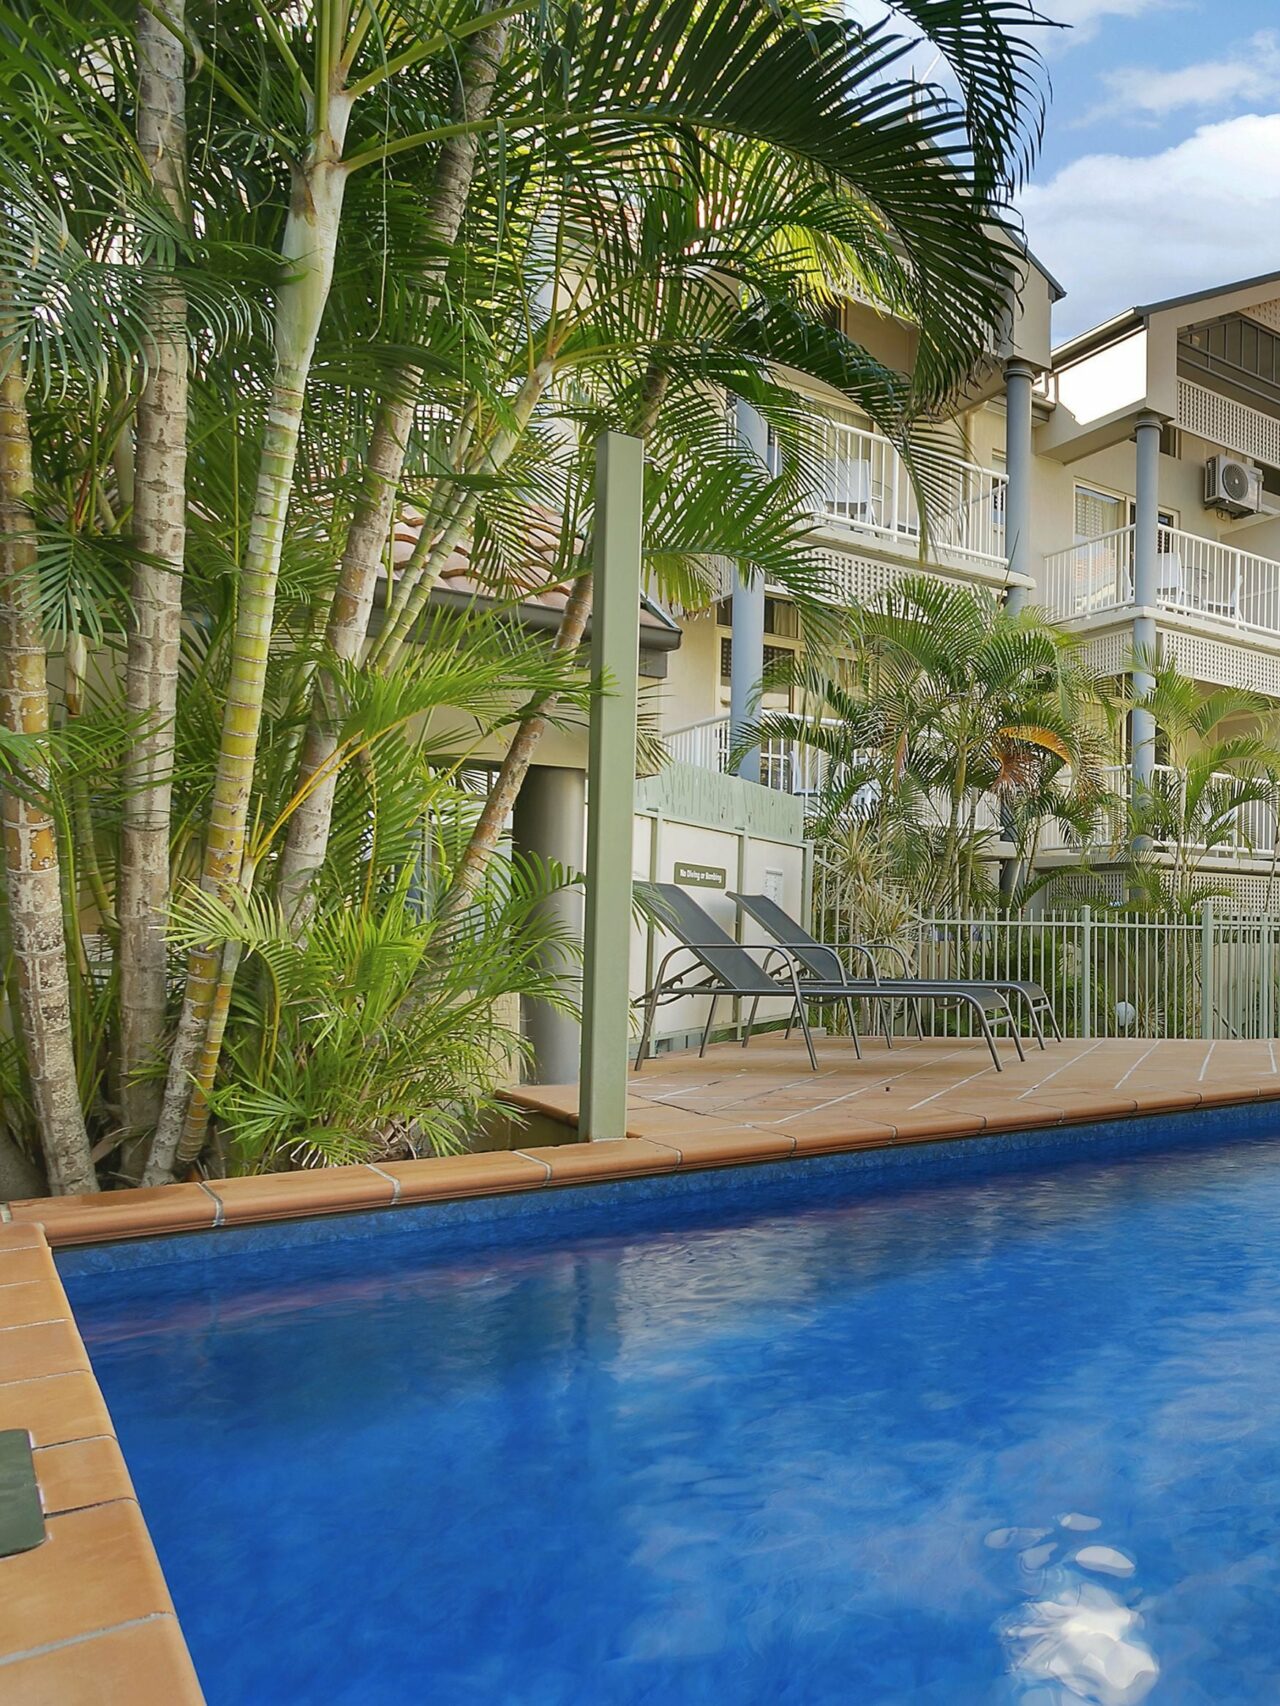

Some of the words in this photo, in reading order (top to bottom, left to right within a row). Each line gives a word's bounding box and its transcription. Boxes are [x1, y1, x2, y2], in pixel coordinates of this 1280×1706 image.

[680, 869, 686, 877] No
[687, 870, 700, 881] Diving
[705, 872, 721, 883] Bombing
